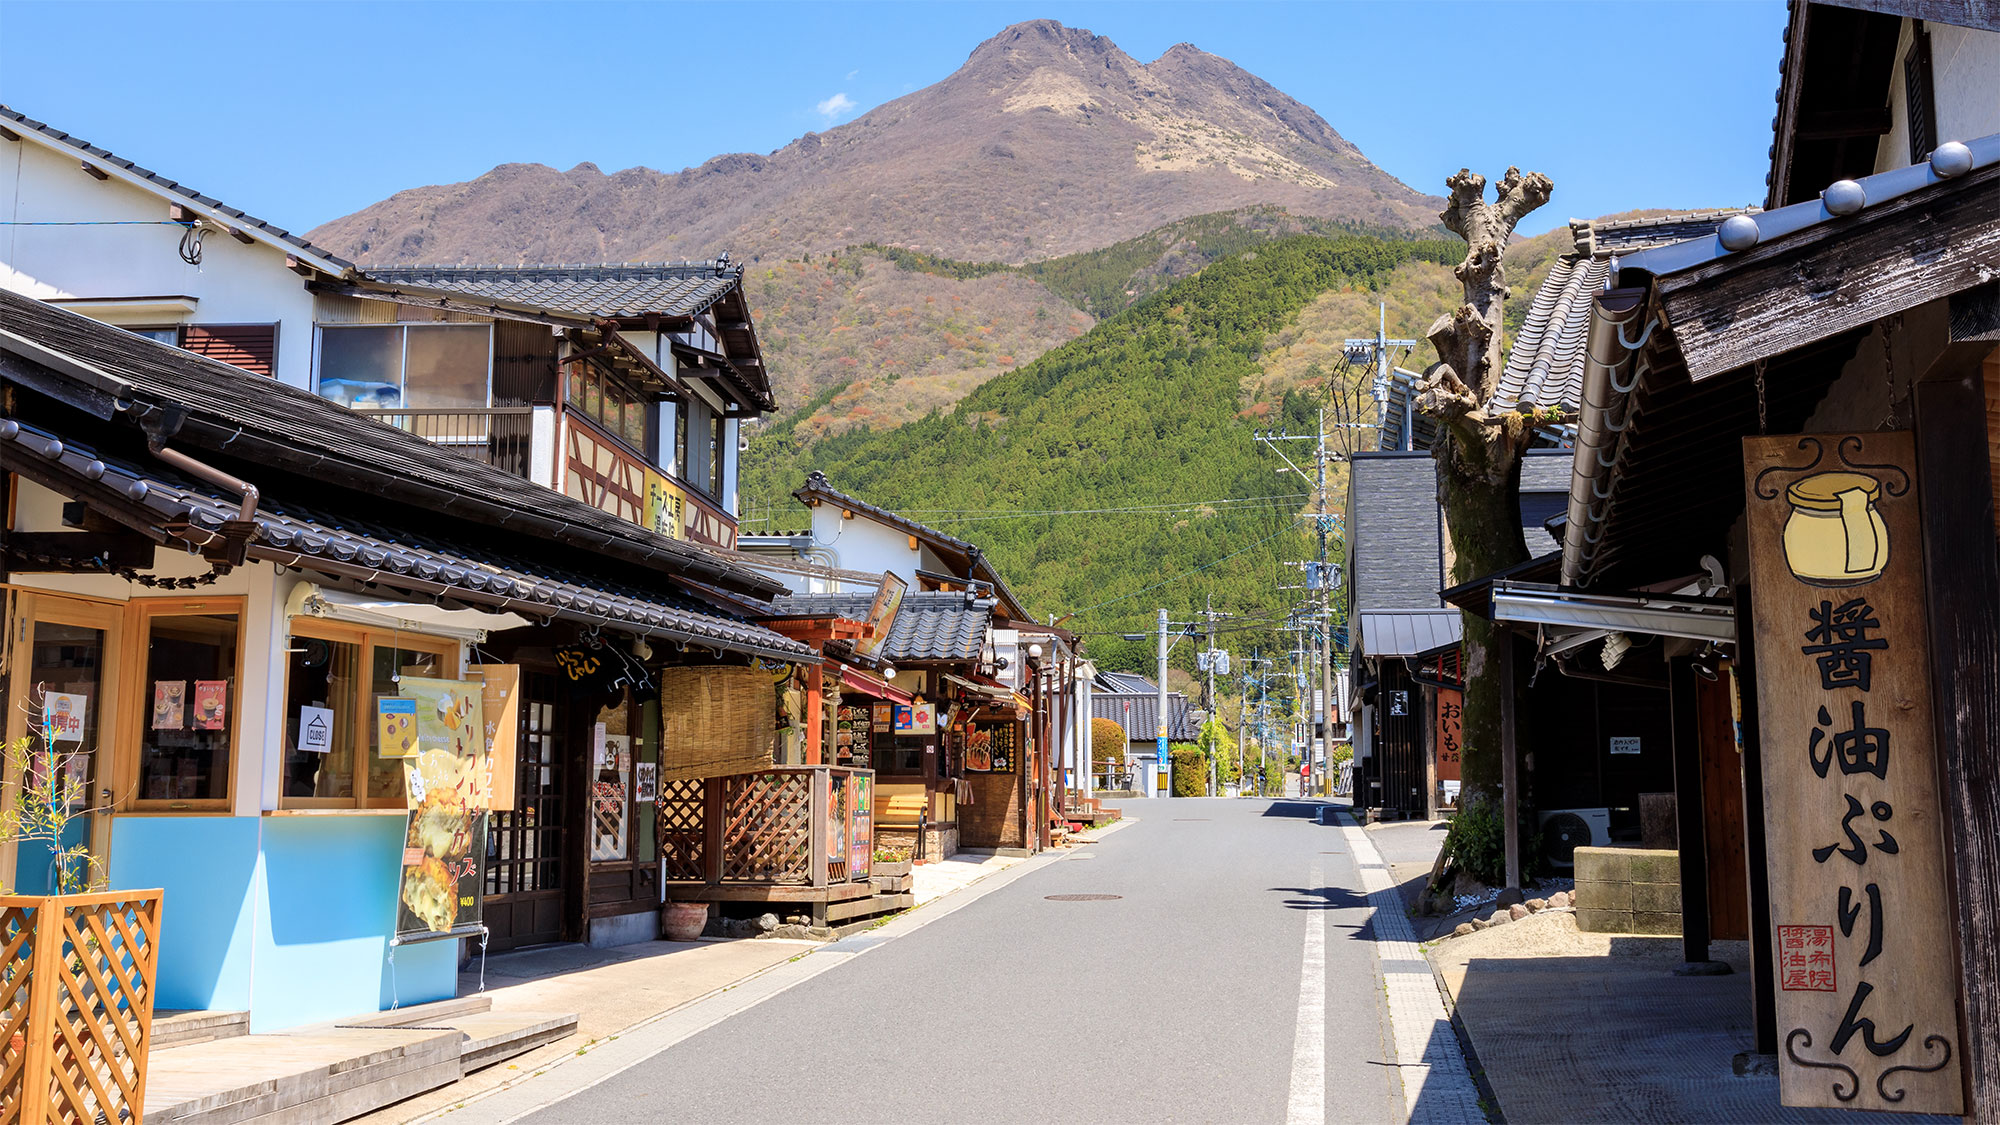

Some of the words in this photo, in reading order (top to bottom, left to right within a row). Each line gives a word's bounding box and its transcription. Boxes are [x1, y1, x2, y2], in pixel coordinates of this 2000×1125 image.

[310, 729, 326, 741] CLOSE
[1441, 702, 1461, 751] おいも
[485, 721, 496, 799] 水色カフェ
[1801, 597, 1914, 1057] 醤油ぷりん
